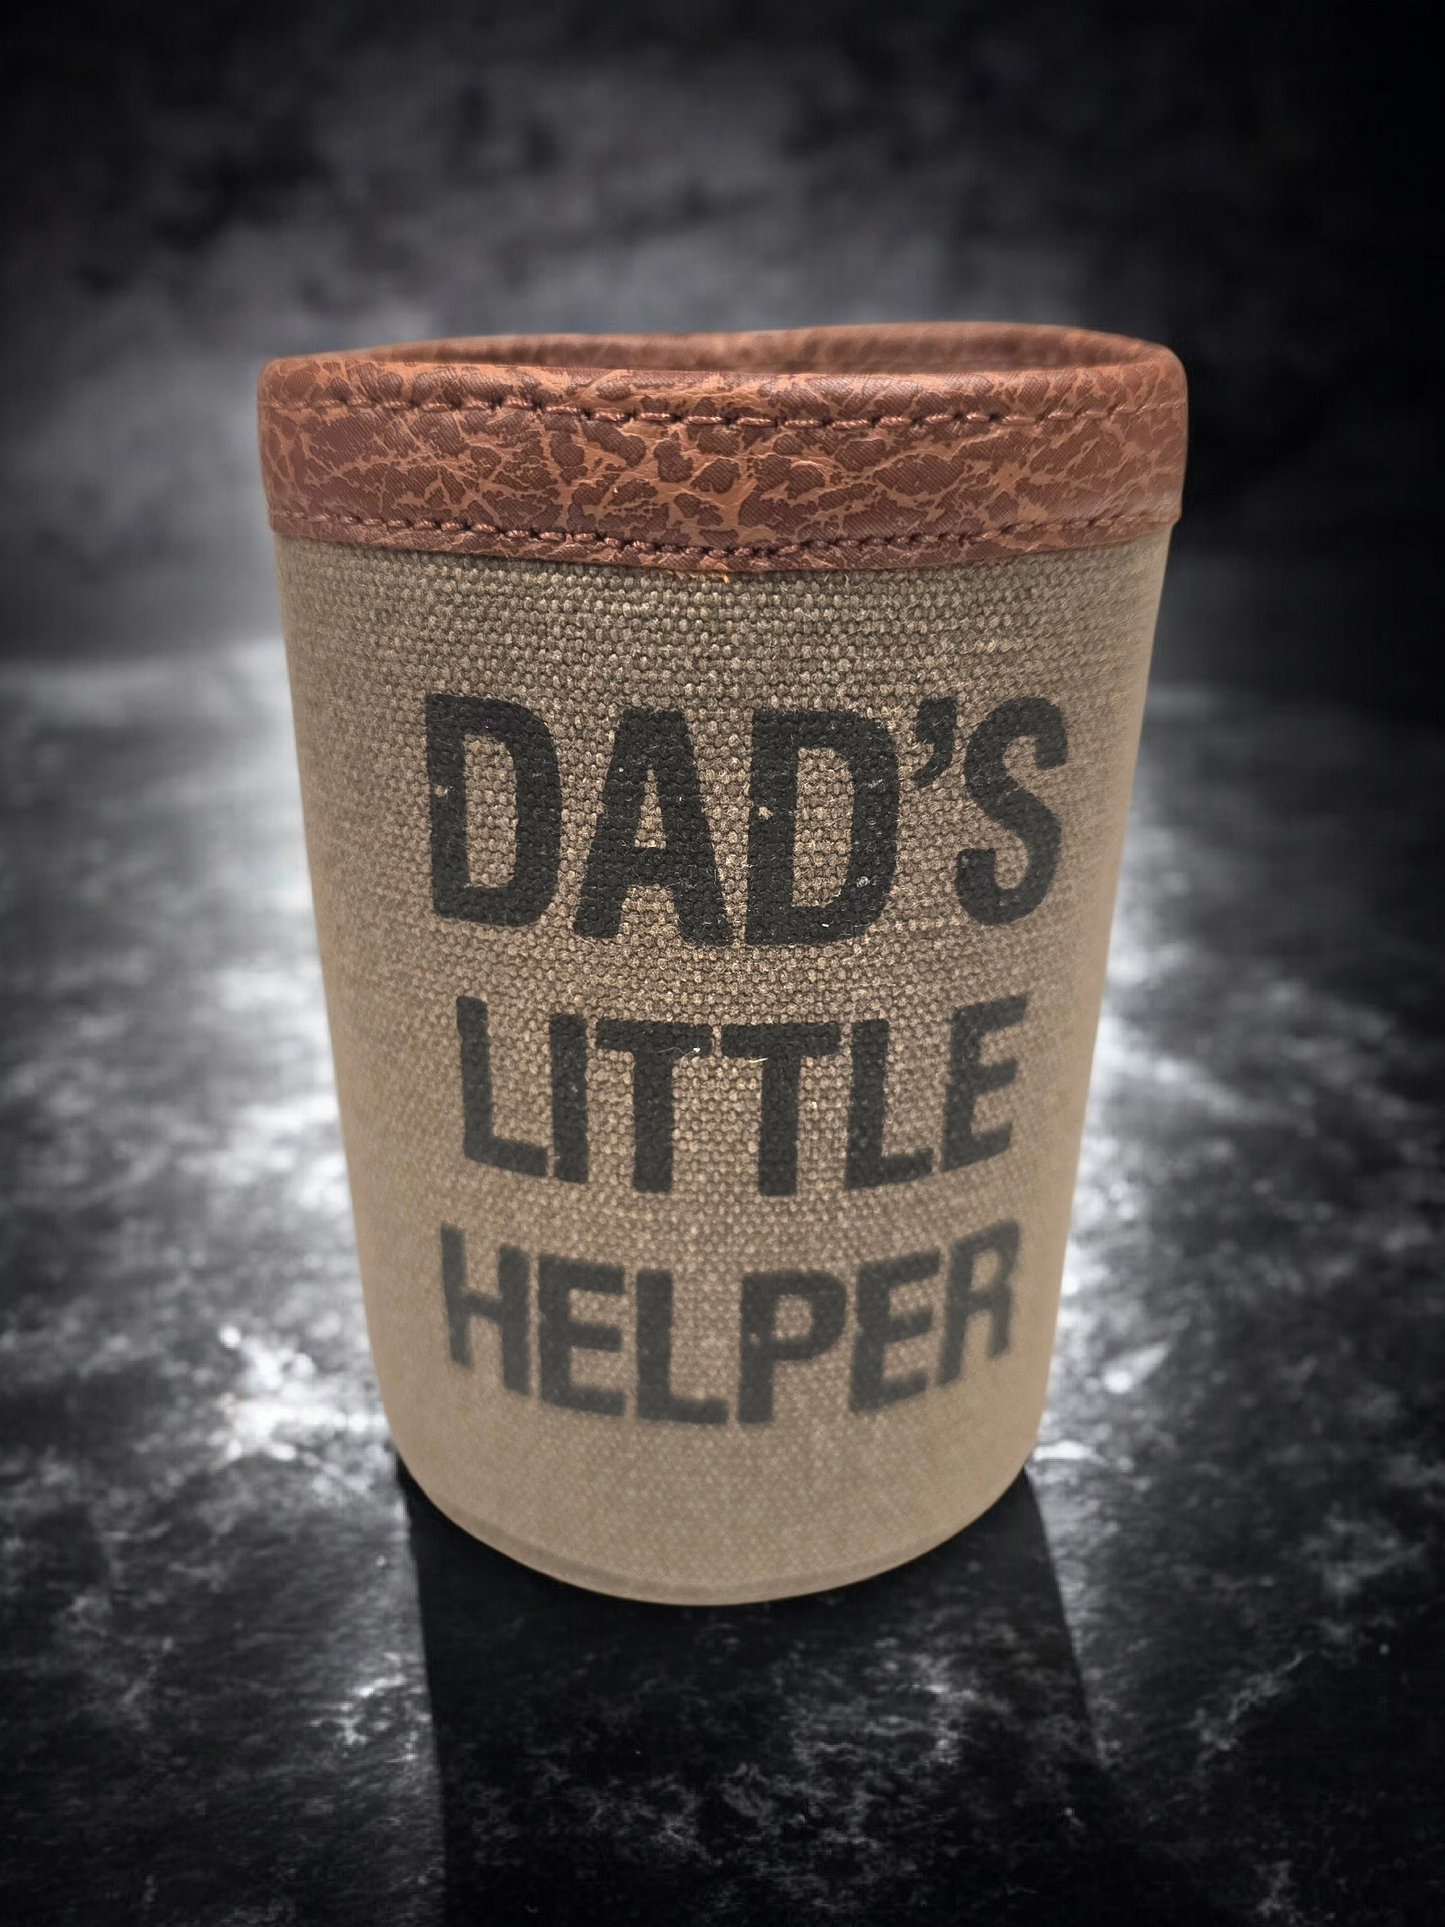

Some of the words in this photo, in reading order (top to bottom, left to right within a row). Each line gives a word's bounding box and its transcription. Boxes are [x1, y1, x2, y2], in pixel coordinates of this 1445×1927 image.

[425, 693, 1068, 945] DAD'S
[456, 995, 1028, 1196] LITTLE
[441, 1219, 1020, 1425] HELPER
